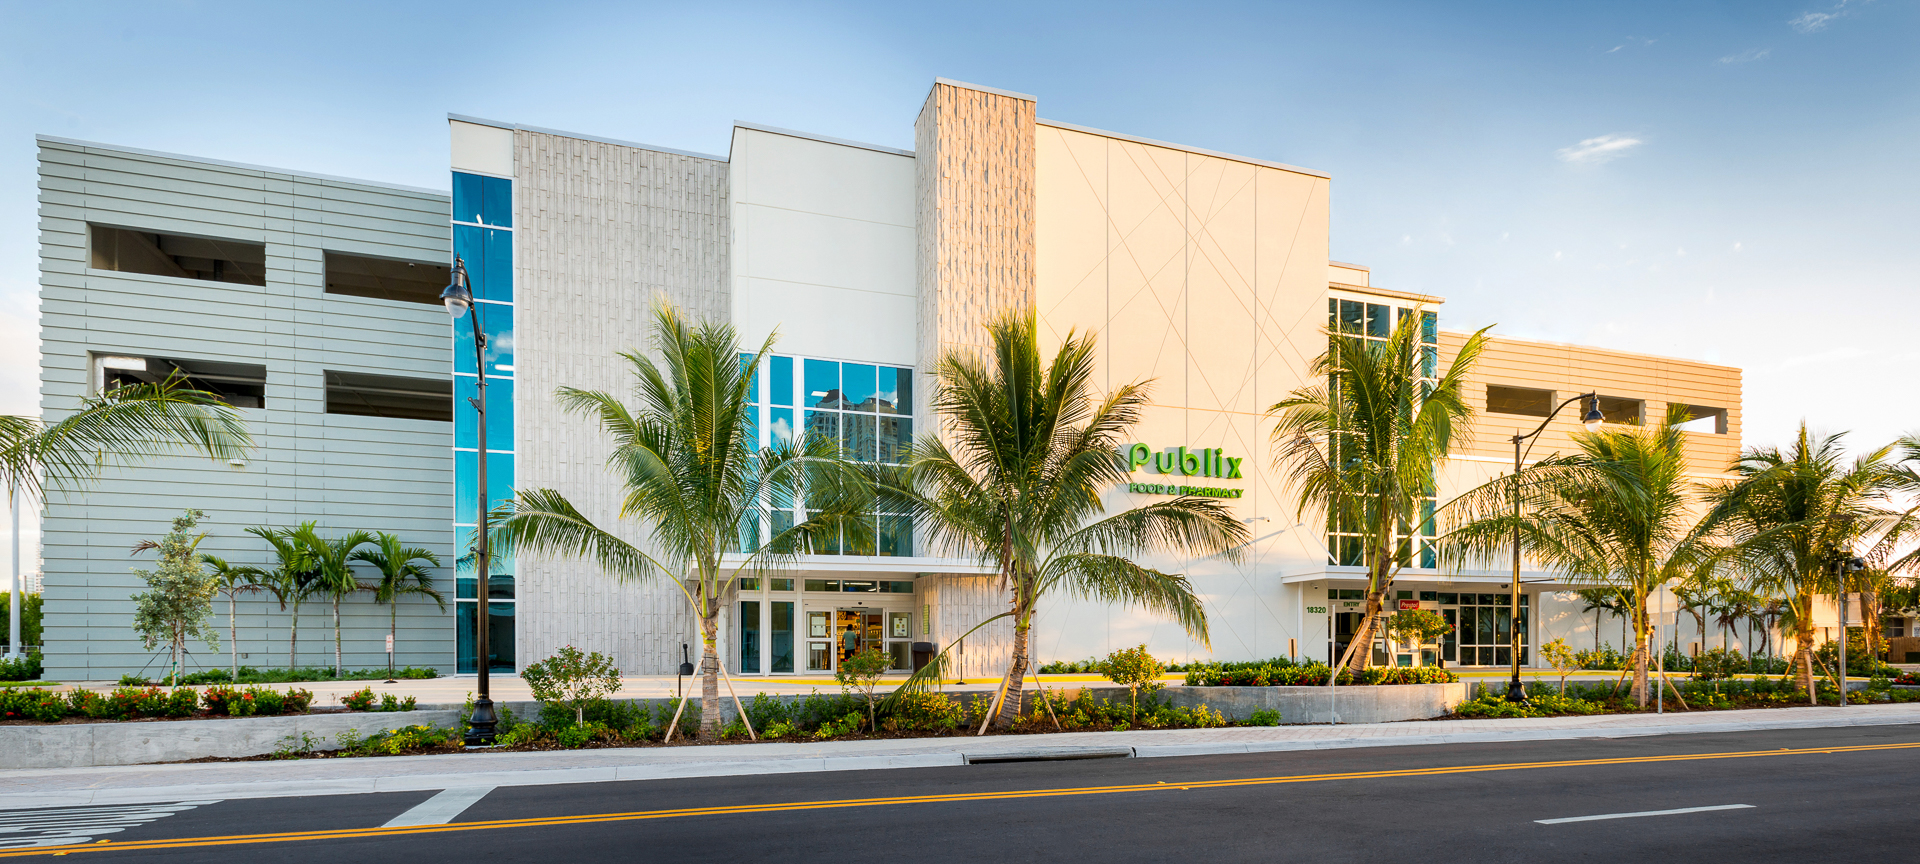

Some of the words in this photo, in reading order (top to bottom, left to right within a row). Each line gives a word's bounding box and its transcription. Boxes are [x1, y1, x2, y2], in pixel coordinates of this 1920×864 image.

[1129, 442, 1243, 479] Publix
[1129, 482, 1165, 494] FOOD
[1167, 484, 1177, 495] &
[1179, 485, 1244, 498] PHARMACY
